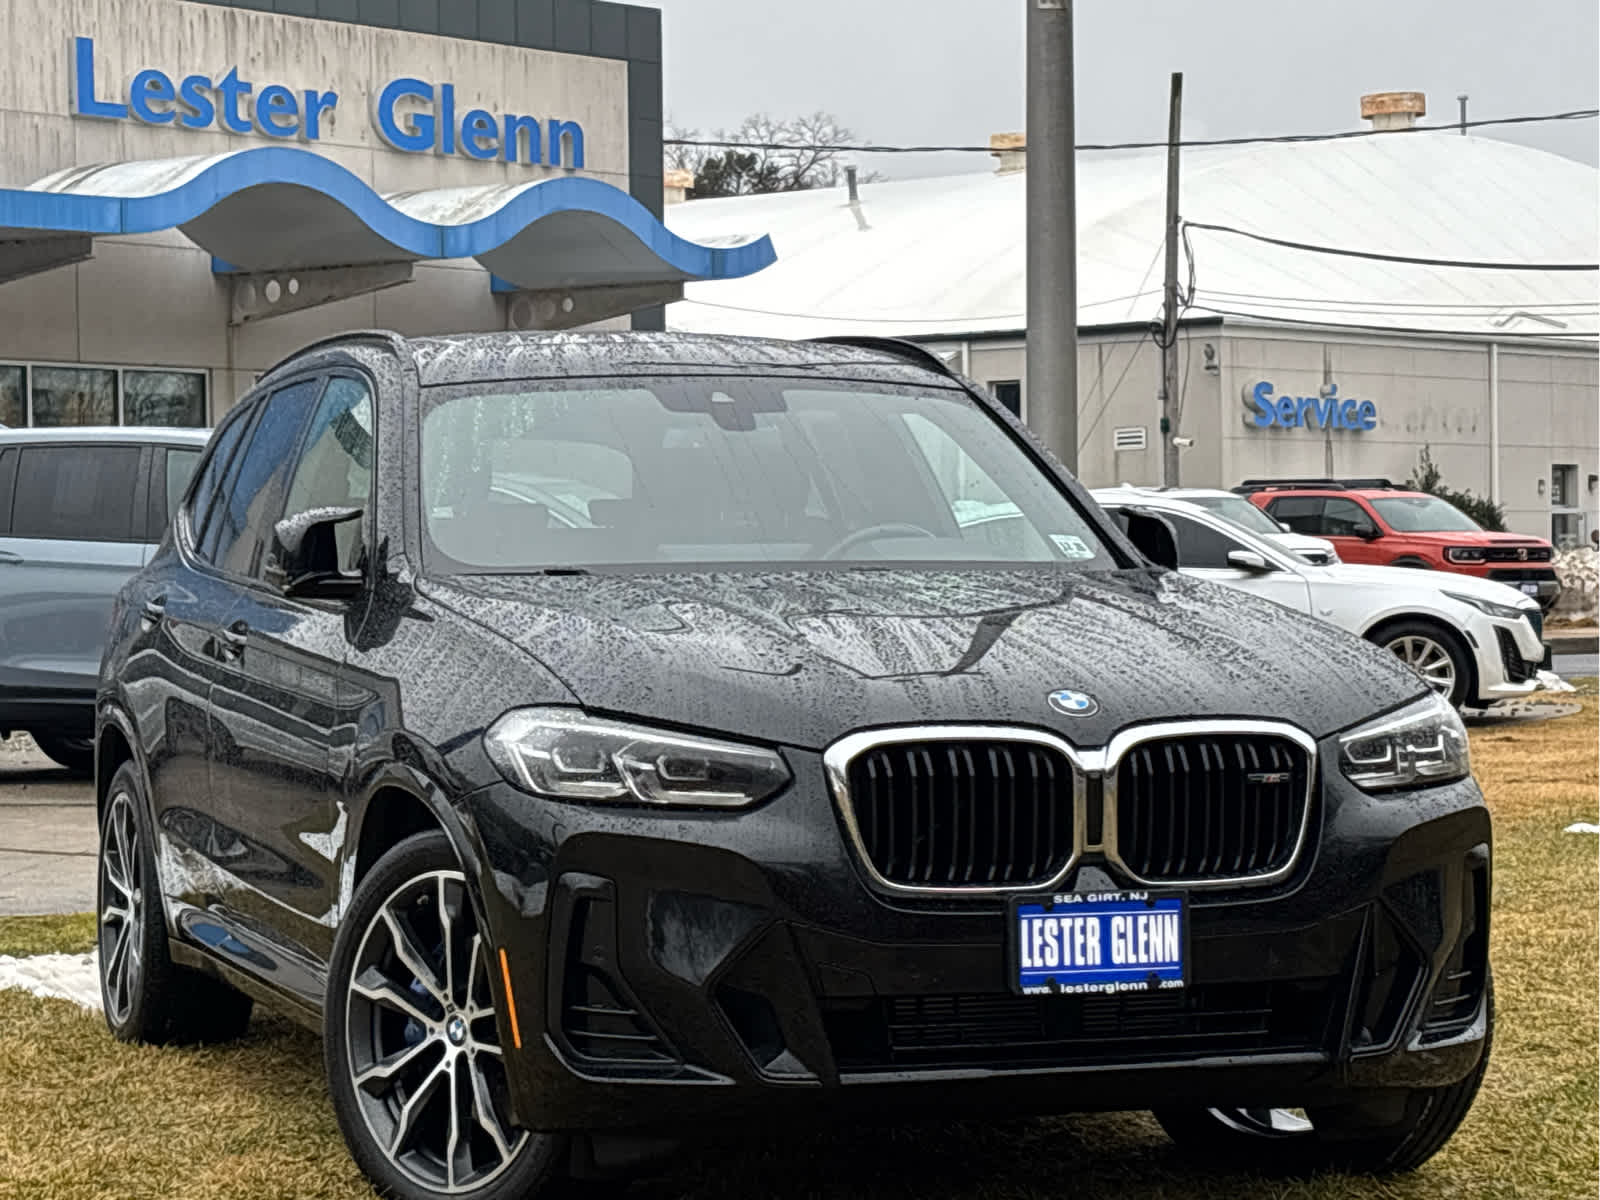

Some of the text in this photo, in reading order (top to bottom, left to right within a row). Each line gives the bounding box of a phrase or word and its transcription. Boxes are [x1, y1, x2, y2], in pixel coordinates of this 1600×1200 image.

[74, 36, 585, 169] Lester Glenn
[1252, 381, 1377, 431] Service
[1053, 894, 1083, 904] SEA
[1129, 891, 1148, 900] NJ
[1020, 914, 1179, 968] LESTER GLENN
[1060, 981, 1148, 994] lesterglenn
